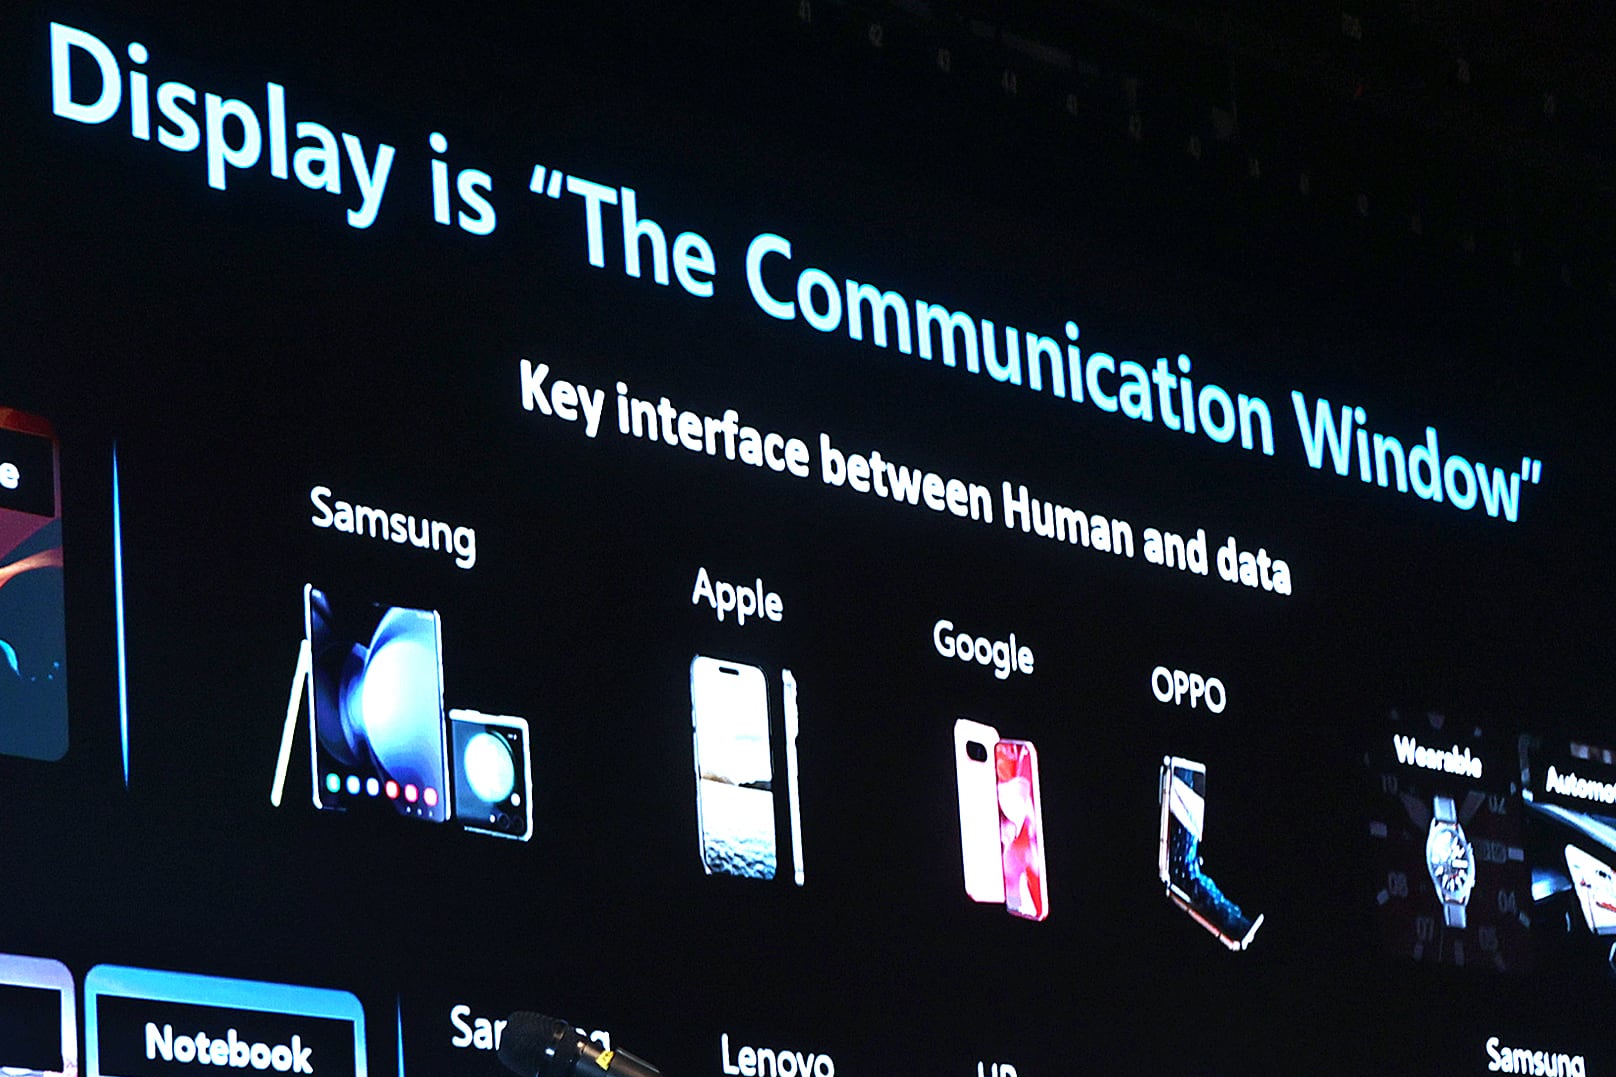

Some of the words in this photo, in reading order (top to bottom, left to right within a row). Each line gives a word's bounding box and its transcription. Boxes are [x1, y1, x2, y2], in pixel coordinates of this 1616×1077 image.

[49, 20, 396, 230] Display
[428, 130, 497, 236] is
[745, 232, 1274, 456] Communication
[519, 358, 605, 438] Key
[615, 381, 810, 478] interface
[820, 431, 993, 524] between
[1002, 480, 1135, 560] Human
[1143, 528, 1210, 577] and
[1218, 536, 1293, 597] data
[310, 485, 477, 571] Samsung
[691, 566, 784, 625] Apple
[933, 620, 1034, 680] Google
[1151, 666, 1227, 714] OPPO
[1393, 734, 1482, 779] Wearable
[1546, 765, 1616, 804] Automo
[145, 1022, 314, 1075] Notebook
